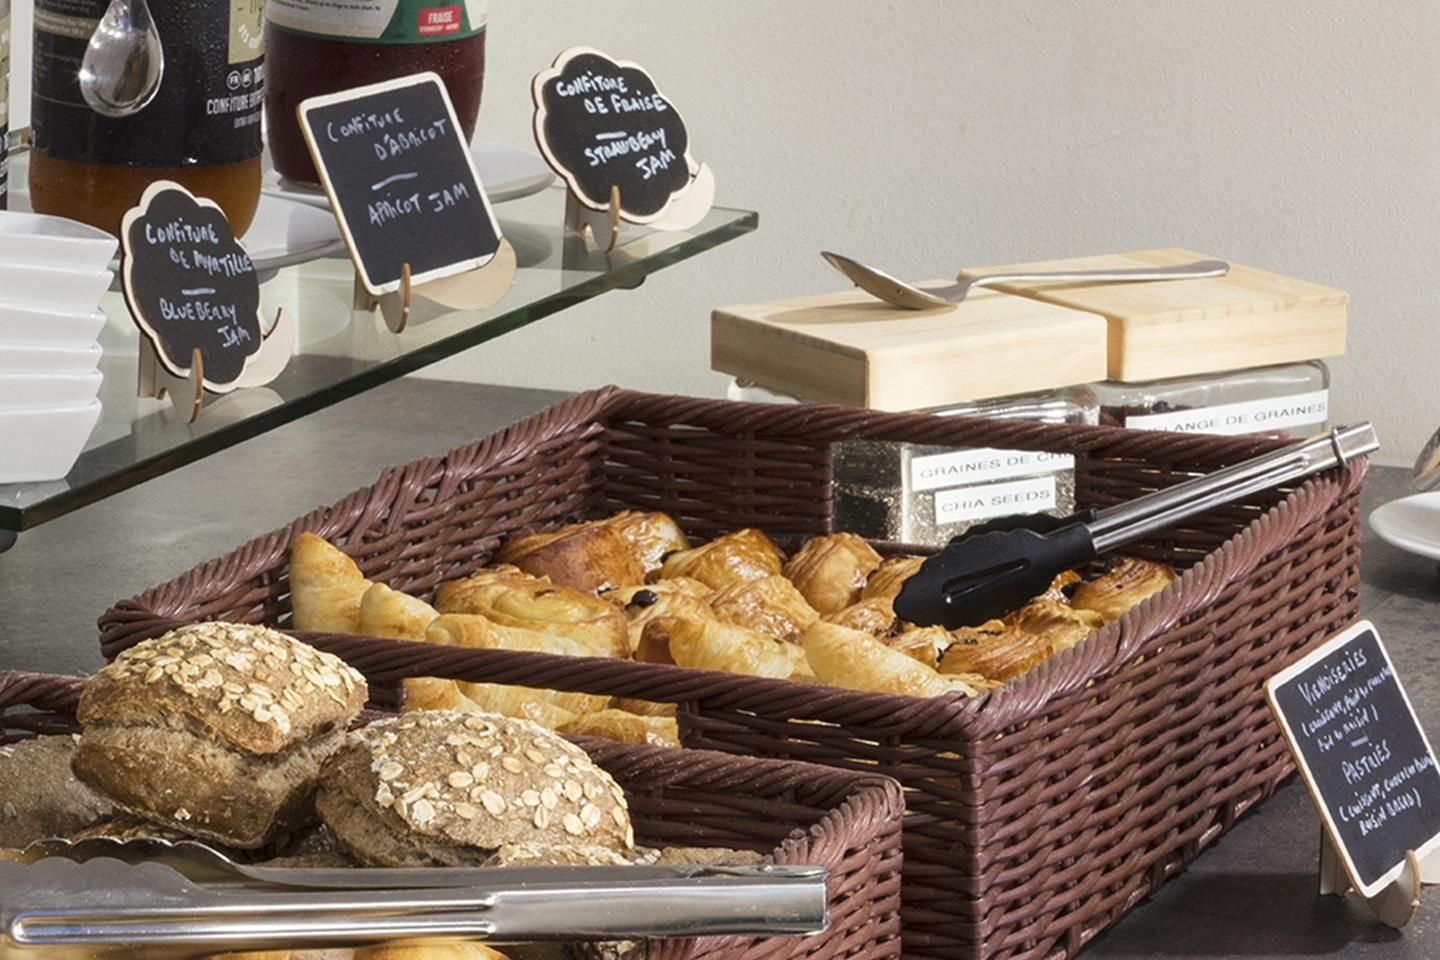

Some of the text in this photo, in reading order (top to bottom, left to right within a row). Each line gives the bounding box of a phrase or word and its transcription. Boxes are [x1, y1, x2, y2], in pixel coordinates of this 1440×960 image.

[428, 10, 454, 24] FRAISE
[556, 70, 628, 97] CONFITURE
[584, 90, 667, 114] DE FRAISE
[328, 108, 405, 142] CONFITURE
[373, 118, 447, 160] D'ABRICOT
[636, 149, 676, 180] JAM
[367, 182, 470, 227] APRICOT JAM
[145, 217, 220, 245] CONFITURE
[169, 247, 254, 277] DE MYRTILLE
[216, 325, 252, 348] JAM
[1225, 415, 1249, 426] DE
[1253, 402, 1326, 422] GRAINES
[920, 458, 1002, 479] GRAINES
[1006, 455, 1030, 467] DE
[941, 489, 1051, 513] CHIA SEEDS
[1342, 739, 1392, 785] PASTRIES
